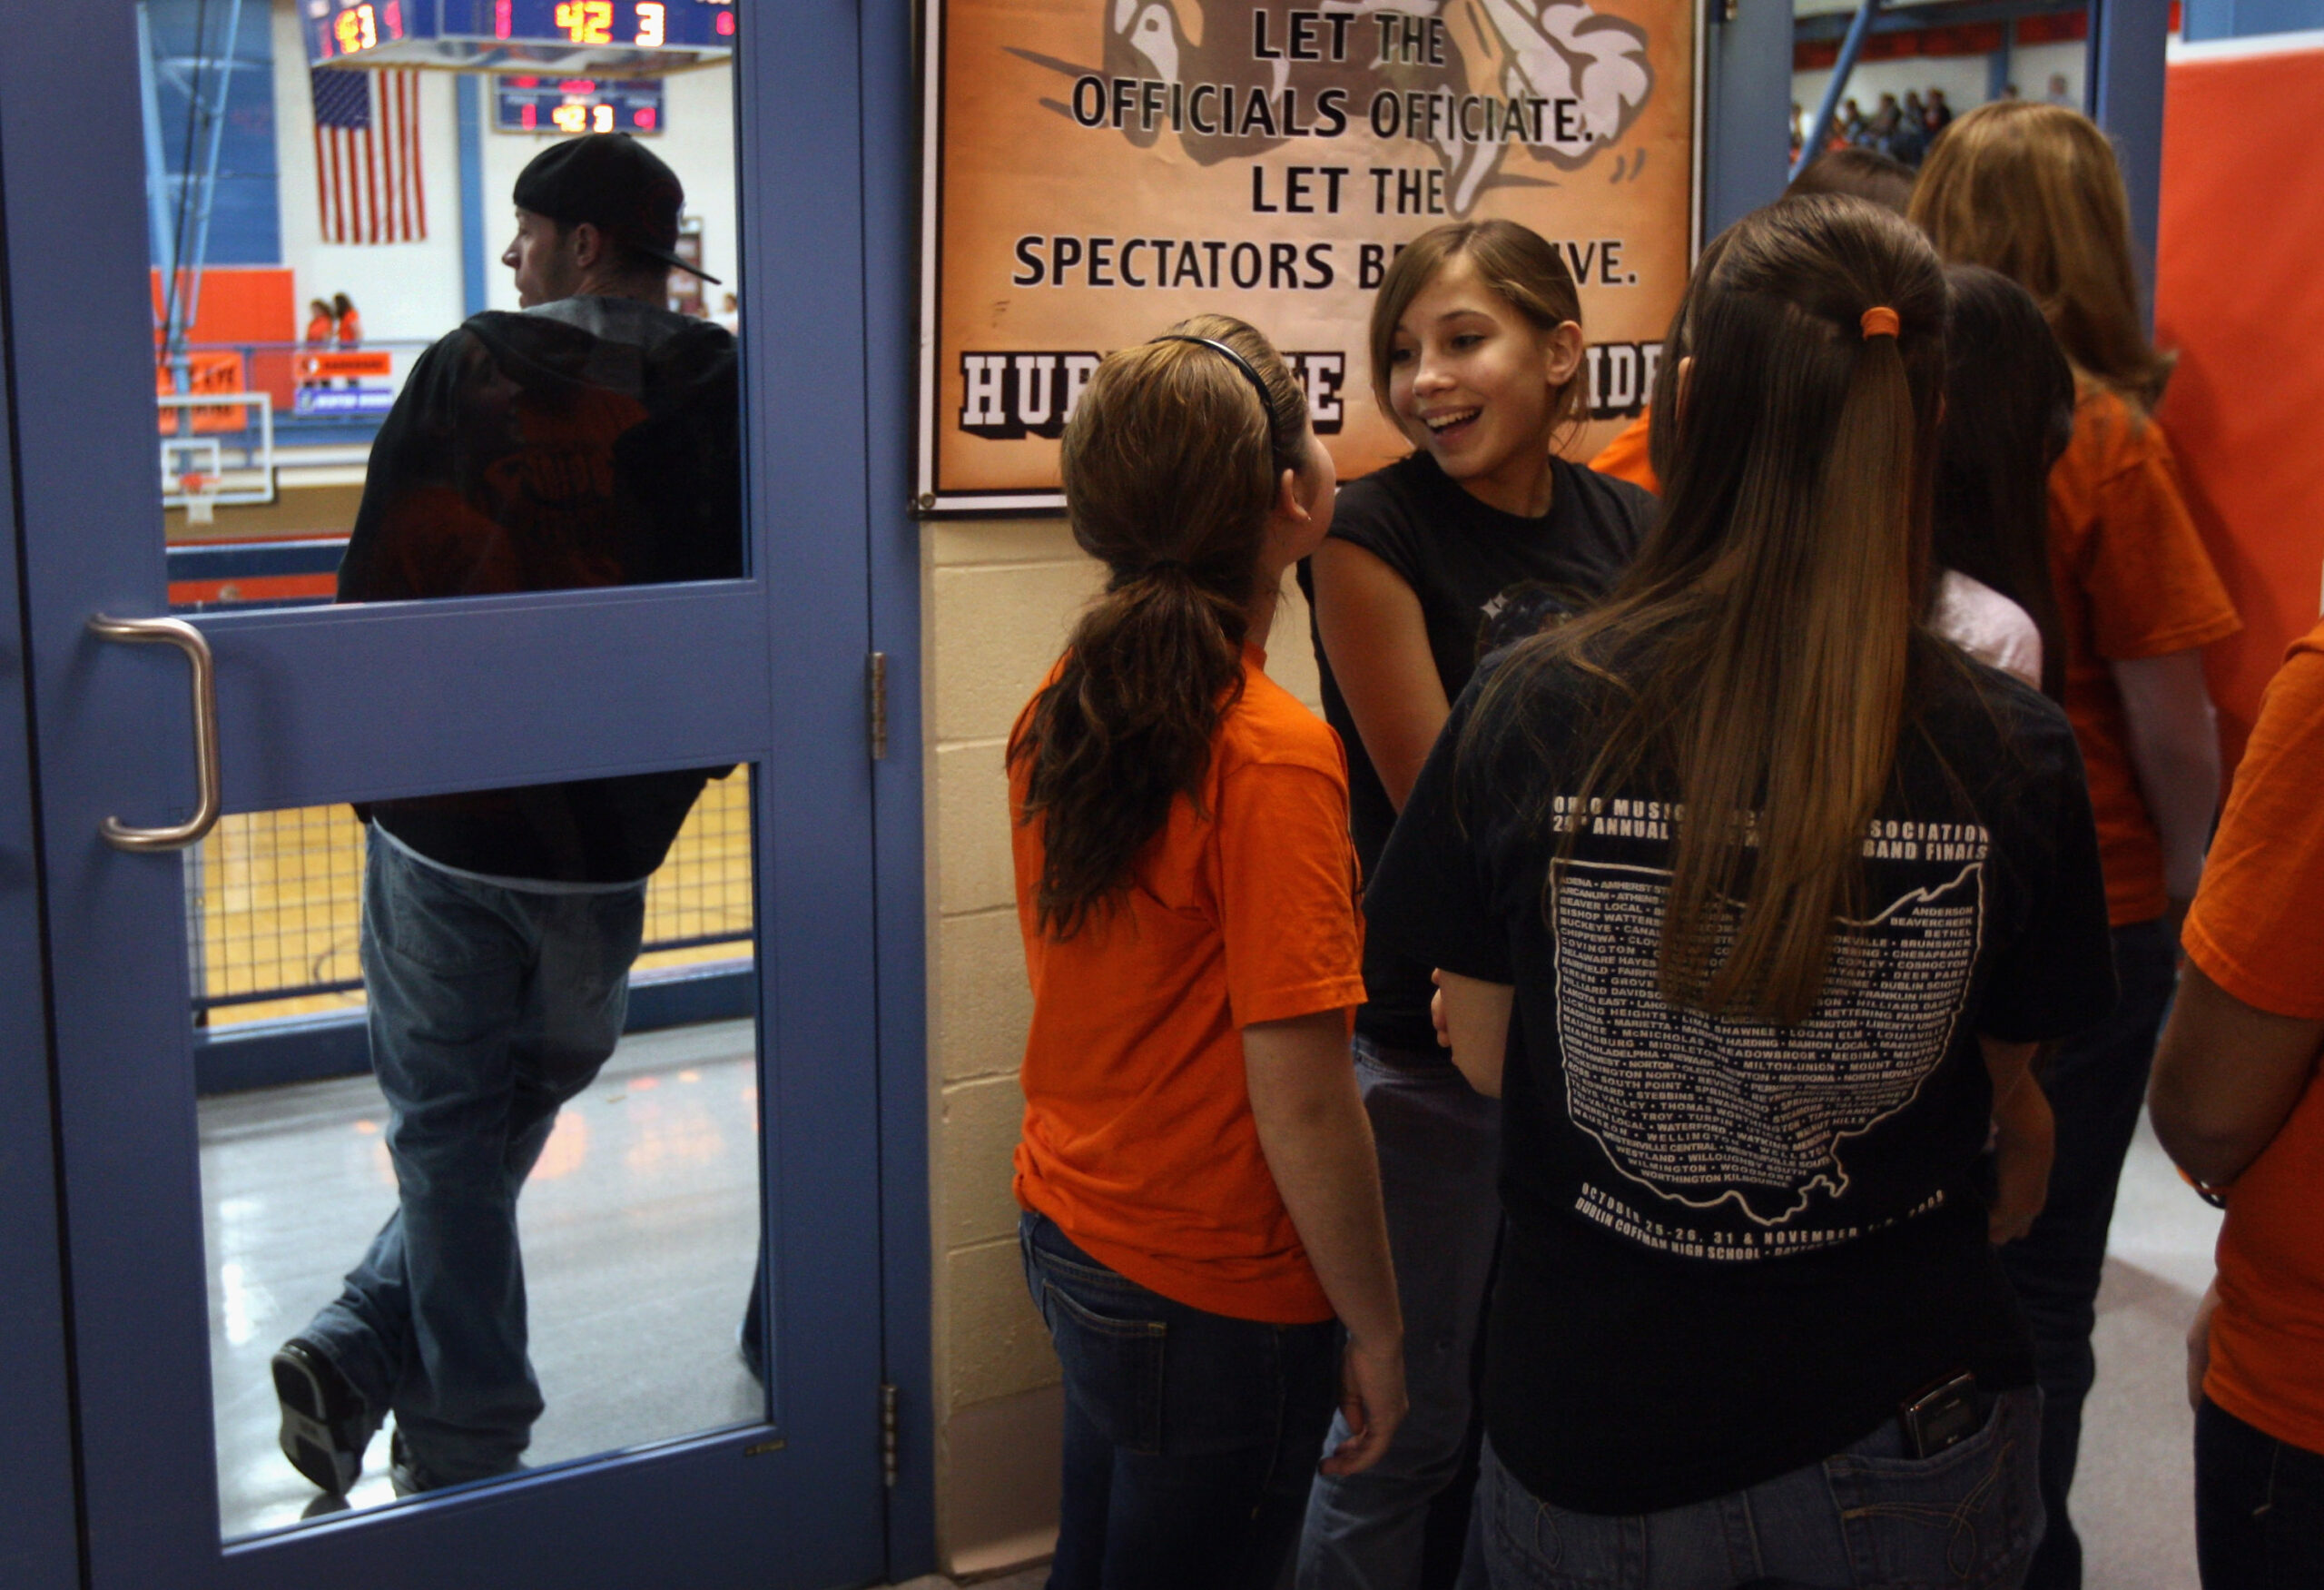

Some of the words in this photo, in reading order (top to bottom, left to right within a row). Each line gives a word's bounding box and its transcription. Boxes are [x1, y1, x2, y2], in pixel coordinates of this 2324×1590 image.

[555, 0, 615, 44] 42
[635, 2, 665, 47] 3
[1255, 10, 1356, 61] LET
[1376, 13, 1445, 65] THE
[1072, 75, 1348, 138] OFFICIALS
[1370, 89, 1593, 142] OFFICIATE.
[1252, 166, 1348, 212] LET
[1368, 168, 1444, 214] THE
[1013, 236, 1334, 289] SPECTATORS
[1614, 798, 1685, 821] MUSIC
[1593, 817, 1669, 840] ANNUAL
[1863, 839, 1917, 860] BAND
[1925, 843, 1988, 861] FINALS
[1561, 887, 1610, 900] ARCANUM
[1617, 892, 1659, 903] ATHENS
[1890, 916, 1973, 927] BEAVERCREEK
[1561, 897, 1601, 911] BEAVER
[1605, 904, 1643, 914] LOCAL
[1924, 928, 1972, 939] BETHEL
[1600, 881, 1653, 894] AMHERST
[1912, 906, 1974, 916] ANDERSON
[1561, 907, 1600, 921] BISHOP
[1900, 939, 1971, 949] BRUNSWICK
[1561, 917, 1611, 933] BUCKEYE
[1624, 924, 1661, 936] CANAL
[1892, 949, 1969, 959] CHESAPEAKE
[1561, 927, 1616, 943] CHIPPEWA
[1896, 959, 1968, 970] COSHOCTON
[1561, 938, 1636, 955] COVINGTON
[1893, 971, 1929, 980] DEER
[1935, 968, 1966, 979] PARK
[1561, 948, 1616, 963] DELAWARE
[1619, 956, 1658, 967] HAYES
[1880, 981, 1925, 990] DUBLIN
[1561, 957, 1609, 974] FAIRFIELD
[1858, 990, 1916, 1001] FRANKLIN
[1561, 966, 1596, 983] GREEN
[1610, 977, 1654, 987] GROVE
[1856, 999, 1919, 1011] HILLIARD
[1562, 975, 1607, 994] HILLIARD
[1610, 987, 1663, 999] DAVIDSO
[1824, 1009, 1893, 1019] KETTERING
[1896, 1006, 1951, 1021] FAIRMONT
[1562, 985, 1596, 1003] LAKOTA
[1599, 997, 1627, 1007] EAST
[1866, 1019, 1915, 1031] LIBERTY
[1562, 995, 1605, 1016] LICKING
[1610, 1008, 1668, 1021] HEIGHTS
[1681, 1014, 1710, 1030] LIMA
[1714, 1023, 1776, 1036] SHAWNEE
[1789, 1026, 1834, 1039] LOGAN
[1838, 1029, 1864, 1039] ELM
[1876, 1025, 1946, 1040] LOUISVILLE
[1562, 1004, 1604, 1024] MADEIRA
[1614, 1018, 1672, 1030] MARIETTA
[1681, 1024, 1723, 1043] MARION
[1726, 1038, 1779, 1048] HARDING
[1788, 1040, 1833, 1050] MARION
[1835, 1041, 1869, 1050] LOCAL
[1879, 1034, 1944, 1049] MARYSVILLE
[1562, 1014, 1607, 1034] MAUMEE
[1622, 1029, 1706, 1047] McNICHOLAS
[1717, 1044, 1817, 1061] MEADOWBROOK
[1830, 1051, 1879, 1062] MEDINA
[1893, 1043, 1940, 1059] MENTOR
[1563, 1023, 1635, 1048] MIAMISBURG
[1648, 1040, 1729, 1064] MIDDLETOWN
[1742, 1061, 1836, 1072] MILTON-UNION
[1849, 1062, 1891, 1072] MOUNT
[1564, 1033, 1583, 1048] NEW
[1583, 1042, 1659, 1059] PHILADELPHIA
[1669, 1052, 1716, 1067] NEWARK
[1844, 1072, 1880, 1081] NORTH
[1881, 1063, 1932, 1079] ROYALTON
[1565, 1042, 1620, 1067] NORTHWEST
[1629, 1060, 1675, 1071] NORTON
[1568, 1062, 1590, 1079] ROSS
[1600, 1075, 1641, 1089] SOUTH
[1645, 1081, 1682, 1090] POINT
[1694, 1085, 1770, 1112] SPRINGBORO
[1602, 1093, 1646, 1109] VALLEY
[1660, 1101, 1712, 1113] THOMAS
[1646, 1070, 1687, 1081] NORTH
[1698, 1075, 1741, 1094] REVERE
[1573, 1098, 1610, 1120] WARREN
[1610, 1114, 1646, 1131] LOCAL
[1657, 1122, 1727, 1135] WATERFORD
[1737, 1131, 1788, 1151] WATKINS
[1574, 1107, 1629, 1136] WAUSEON
[1647, 1131, 1740, 1146] WELLINGTON
[1636, 1091, 1695, 1101] STEBBINS
[1706, 1096, 1761, 1120] SWANTON
[1641, 1111, 1673, 1121] TROY
[1688, 1112, 1734, 1126] TURPIN
[1833, 1117, 1866, 1125] HILLS
[1602, 1129, 1668, 1152] WESTERVILLE
[1669, 1142, 1717, 1152] CENTRAL
[1616, 1145, 1676, 1162] WESTLAND
[1688, 1153, 1763, 1169] WILLOUGHBY
[1766, 1163, 1807, 1177] SOUTH
[1628, 1158, 1707, 1173] WILMINGTON
[1720, 1163, 1792, 1181] WOODMORE
[1640, 1169, 1721, 1183] WORTHINGTON
[1723, 1173, 1789, 1188] KILBOURNE
[1575, 1196, 1612, 1229] DUBLIN
[1614, 1220, 1668, 1250] COFFMAN
[1670, 1240, 1704, 1258] HIGH
[1707, 1246, 1760, 1260] SCHOOL
[1581, 1181, 1640, 1224] OCTOBER
[1714, 1231, 1734, 1245] 31
[1743, 1231, 1753, 1246] &
[1764, 1226, 1858, 1246] NOVEMBER
